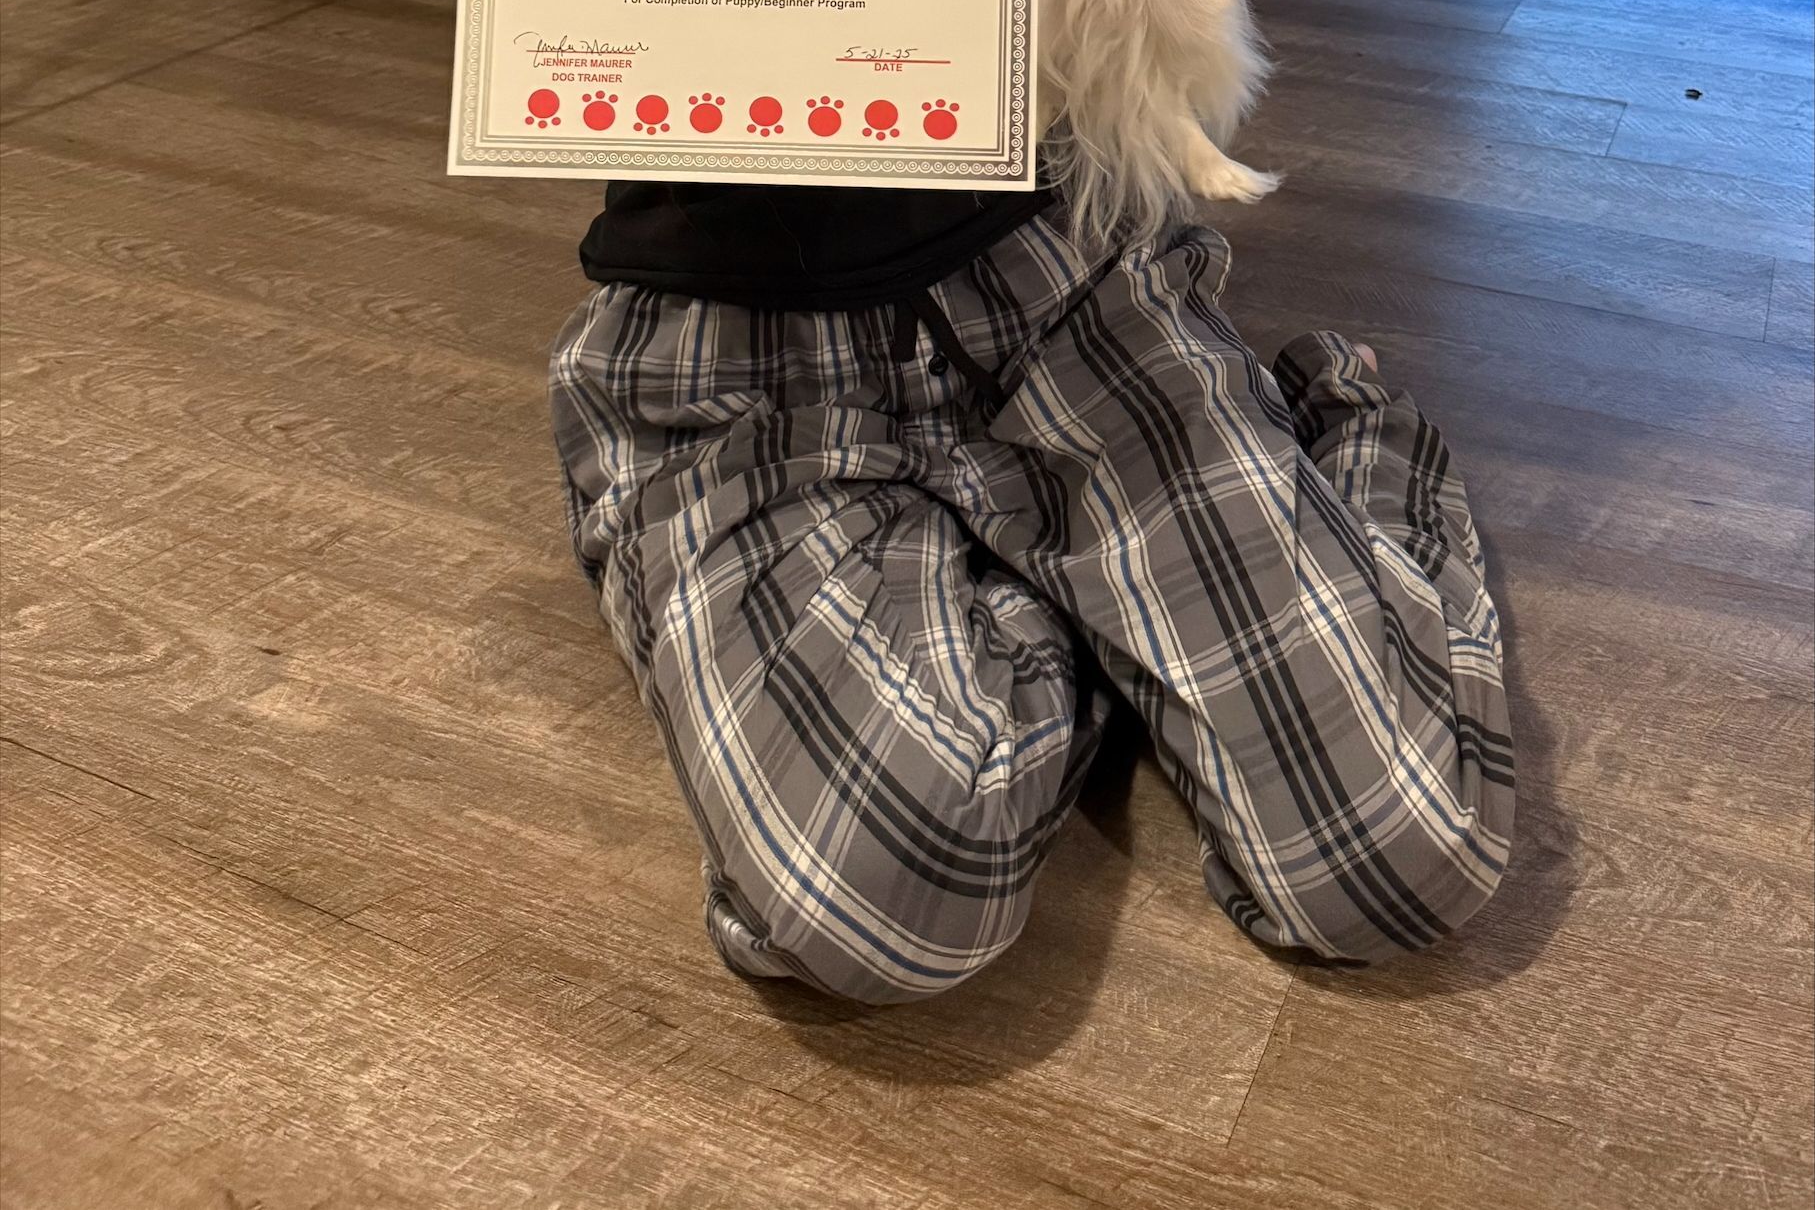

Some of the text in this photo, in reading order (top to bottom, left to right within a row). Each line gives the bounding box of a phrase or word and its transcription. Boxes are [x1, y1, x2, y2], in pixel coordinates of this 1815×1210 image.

[844, 46, 919, 60] 5-21-25
[541, 57, 632, 69] JENNIFER MAURER
[874, 62, 903, 72] DATE
[551, 72, 623, 83] DOG TRAINER
